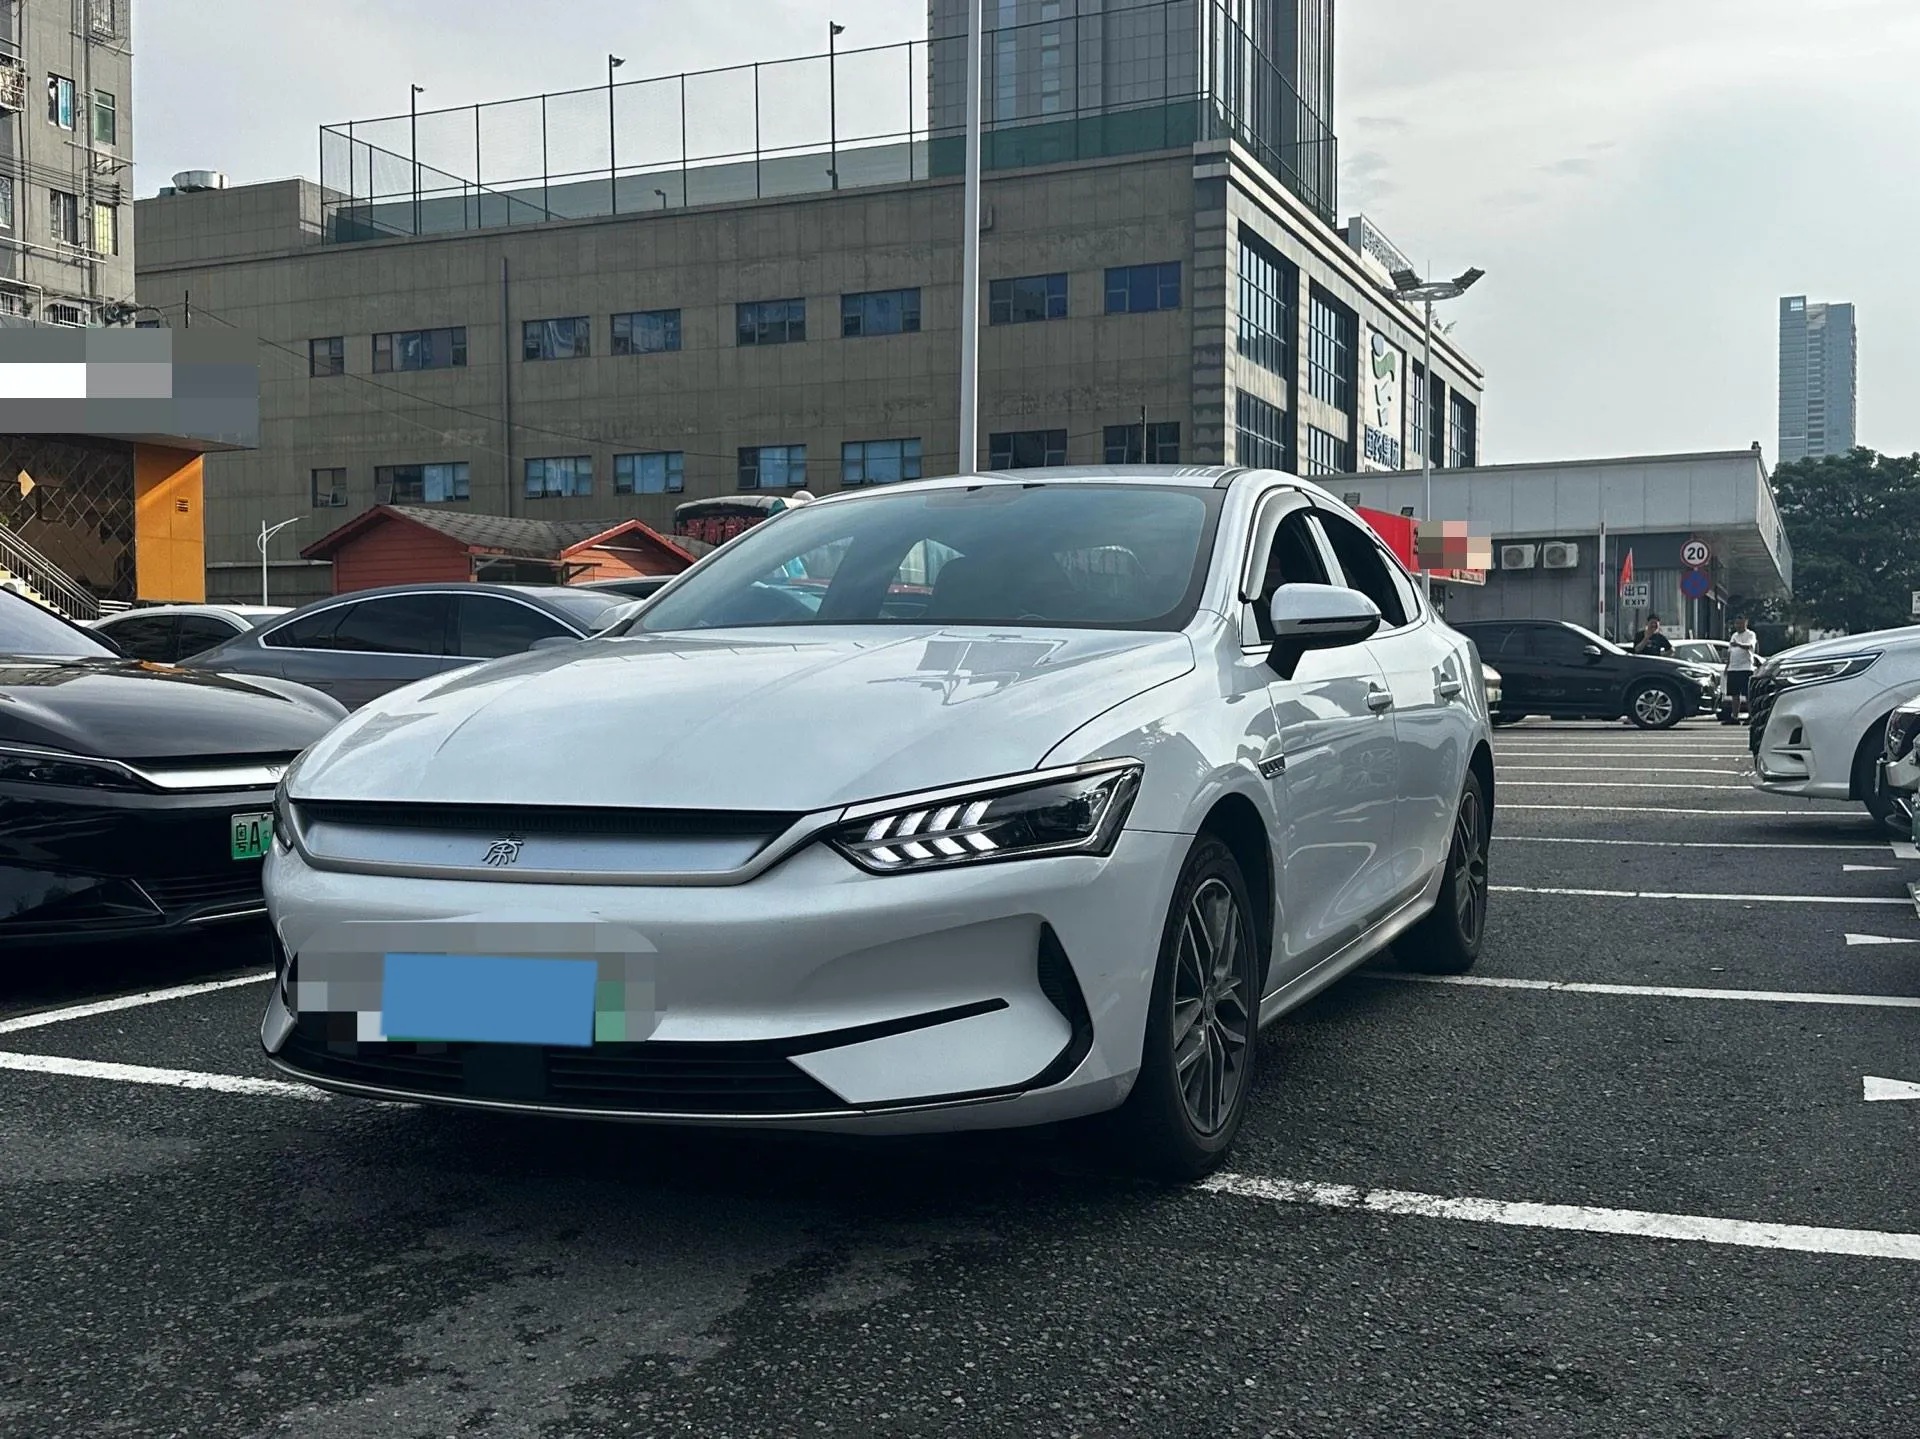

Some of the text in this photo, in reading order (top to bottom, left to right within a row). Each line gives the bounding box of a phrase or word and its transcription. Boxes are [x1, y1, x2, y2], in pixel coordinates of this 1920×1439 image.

[1687, 547, 1705, 560] 20
[1624, 585, 1647, 596] 出口
[235, 821, 261, 852] 粤A
